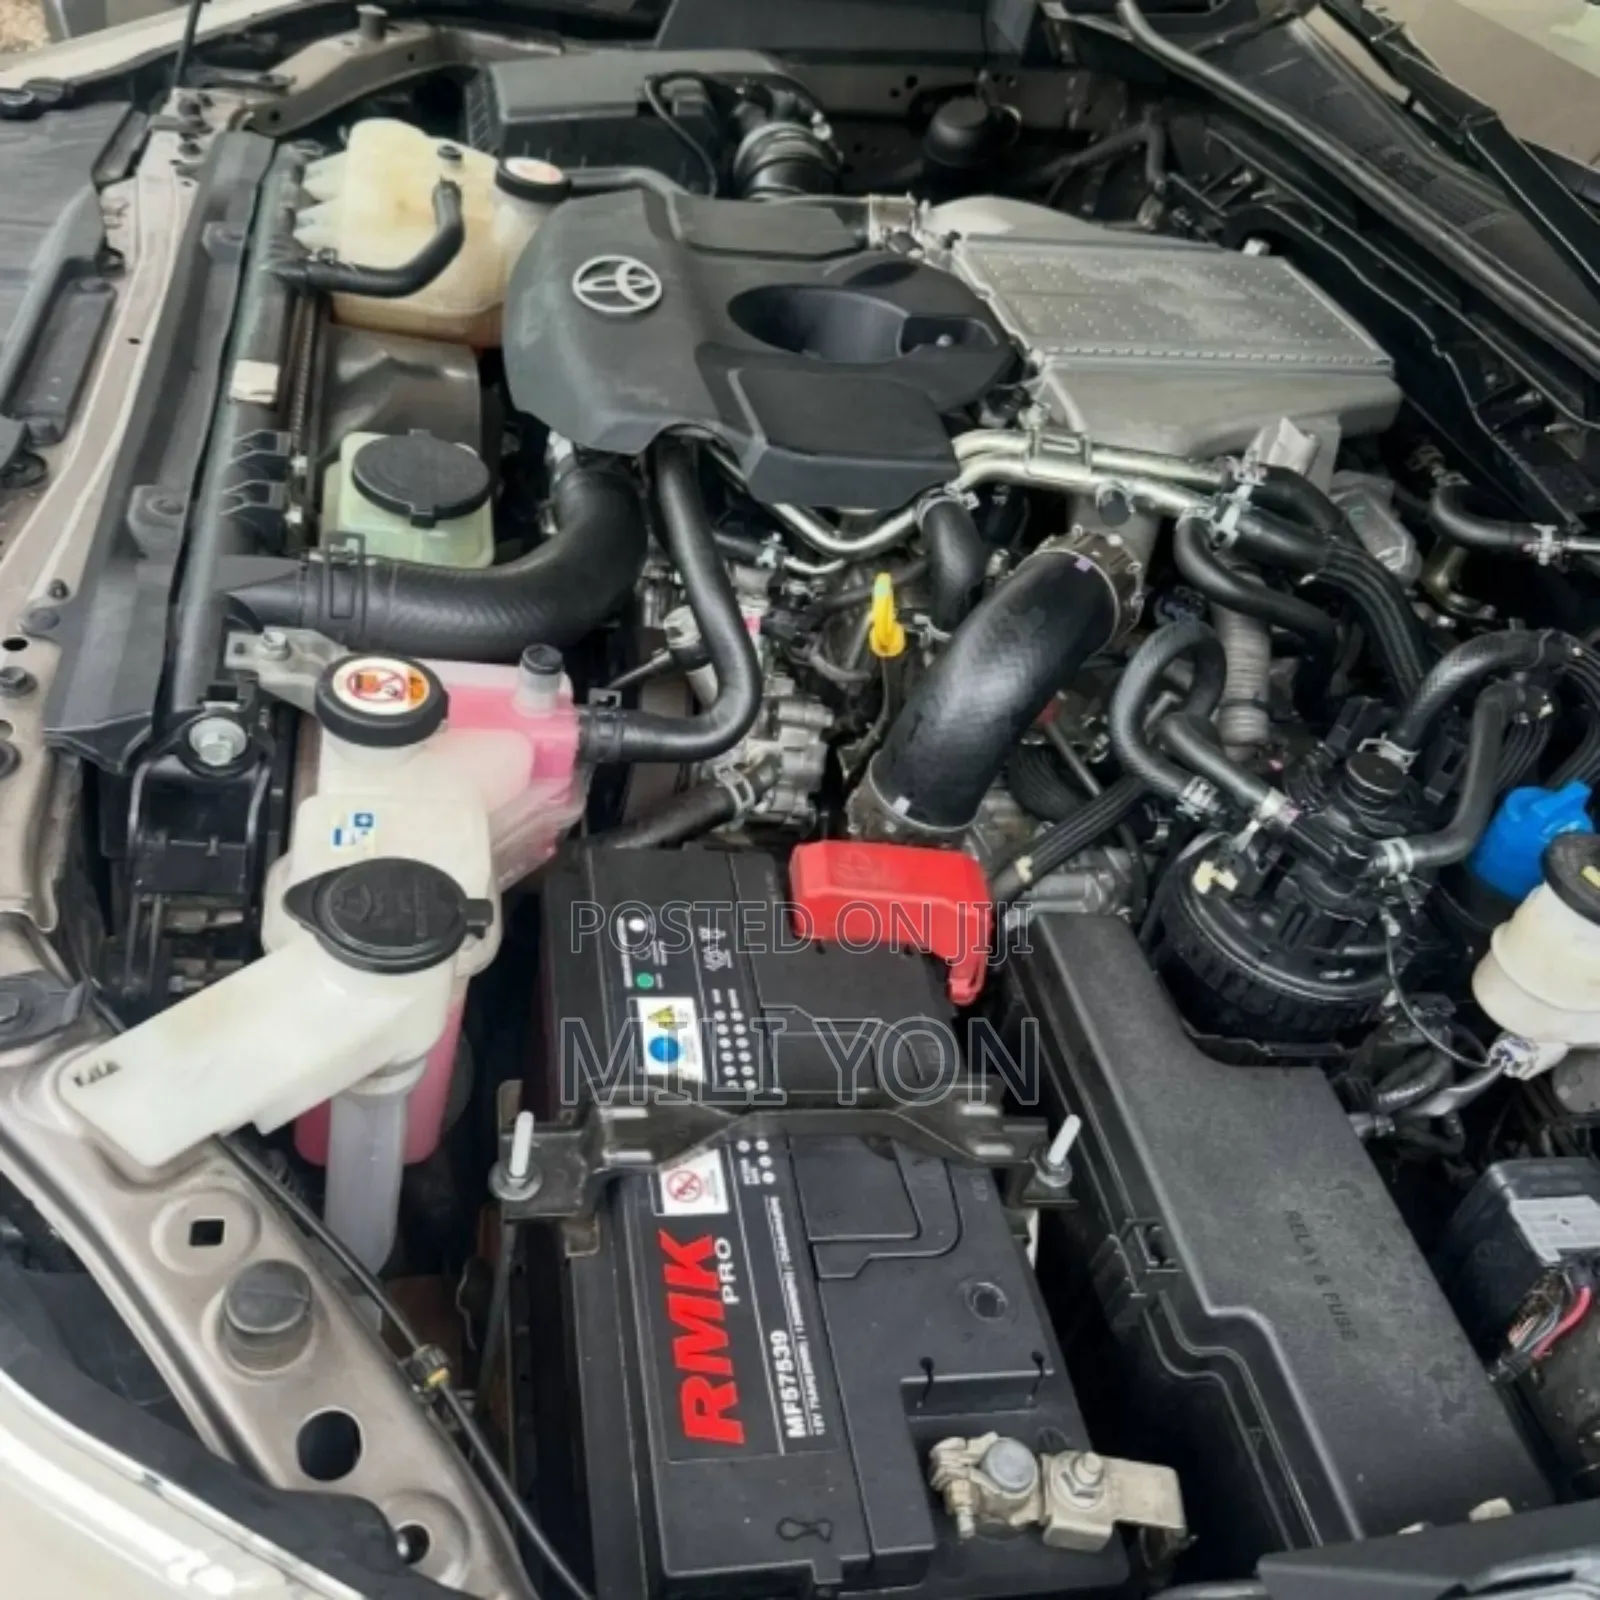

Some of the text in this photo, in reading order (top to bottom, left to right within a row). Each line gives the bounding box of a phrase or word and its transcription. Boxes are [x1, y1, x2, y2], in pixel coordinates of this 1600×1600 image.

[714, 1237, 740, 1305] PRO
[1284, 1210, 1325, 1267] RELAY
[1322, 1291, 1358, 1342] FUSE
[658, 1228, 745, 1444] RMK
[770, 1330, 807, 1438] MF57539
